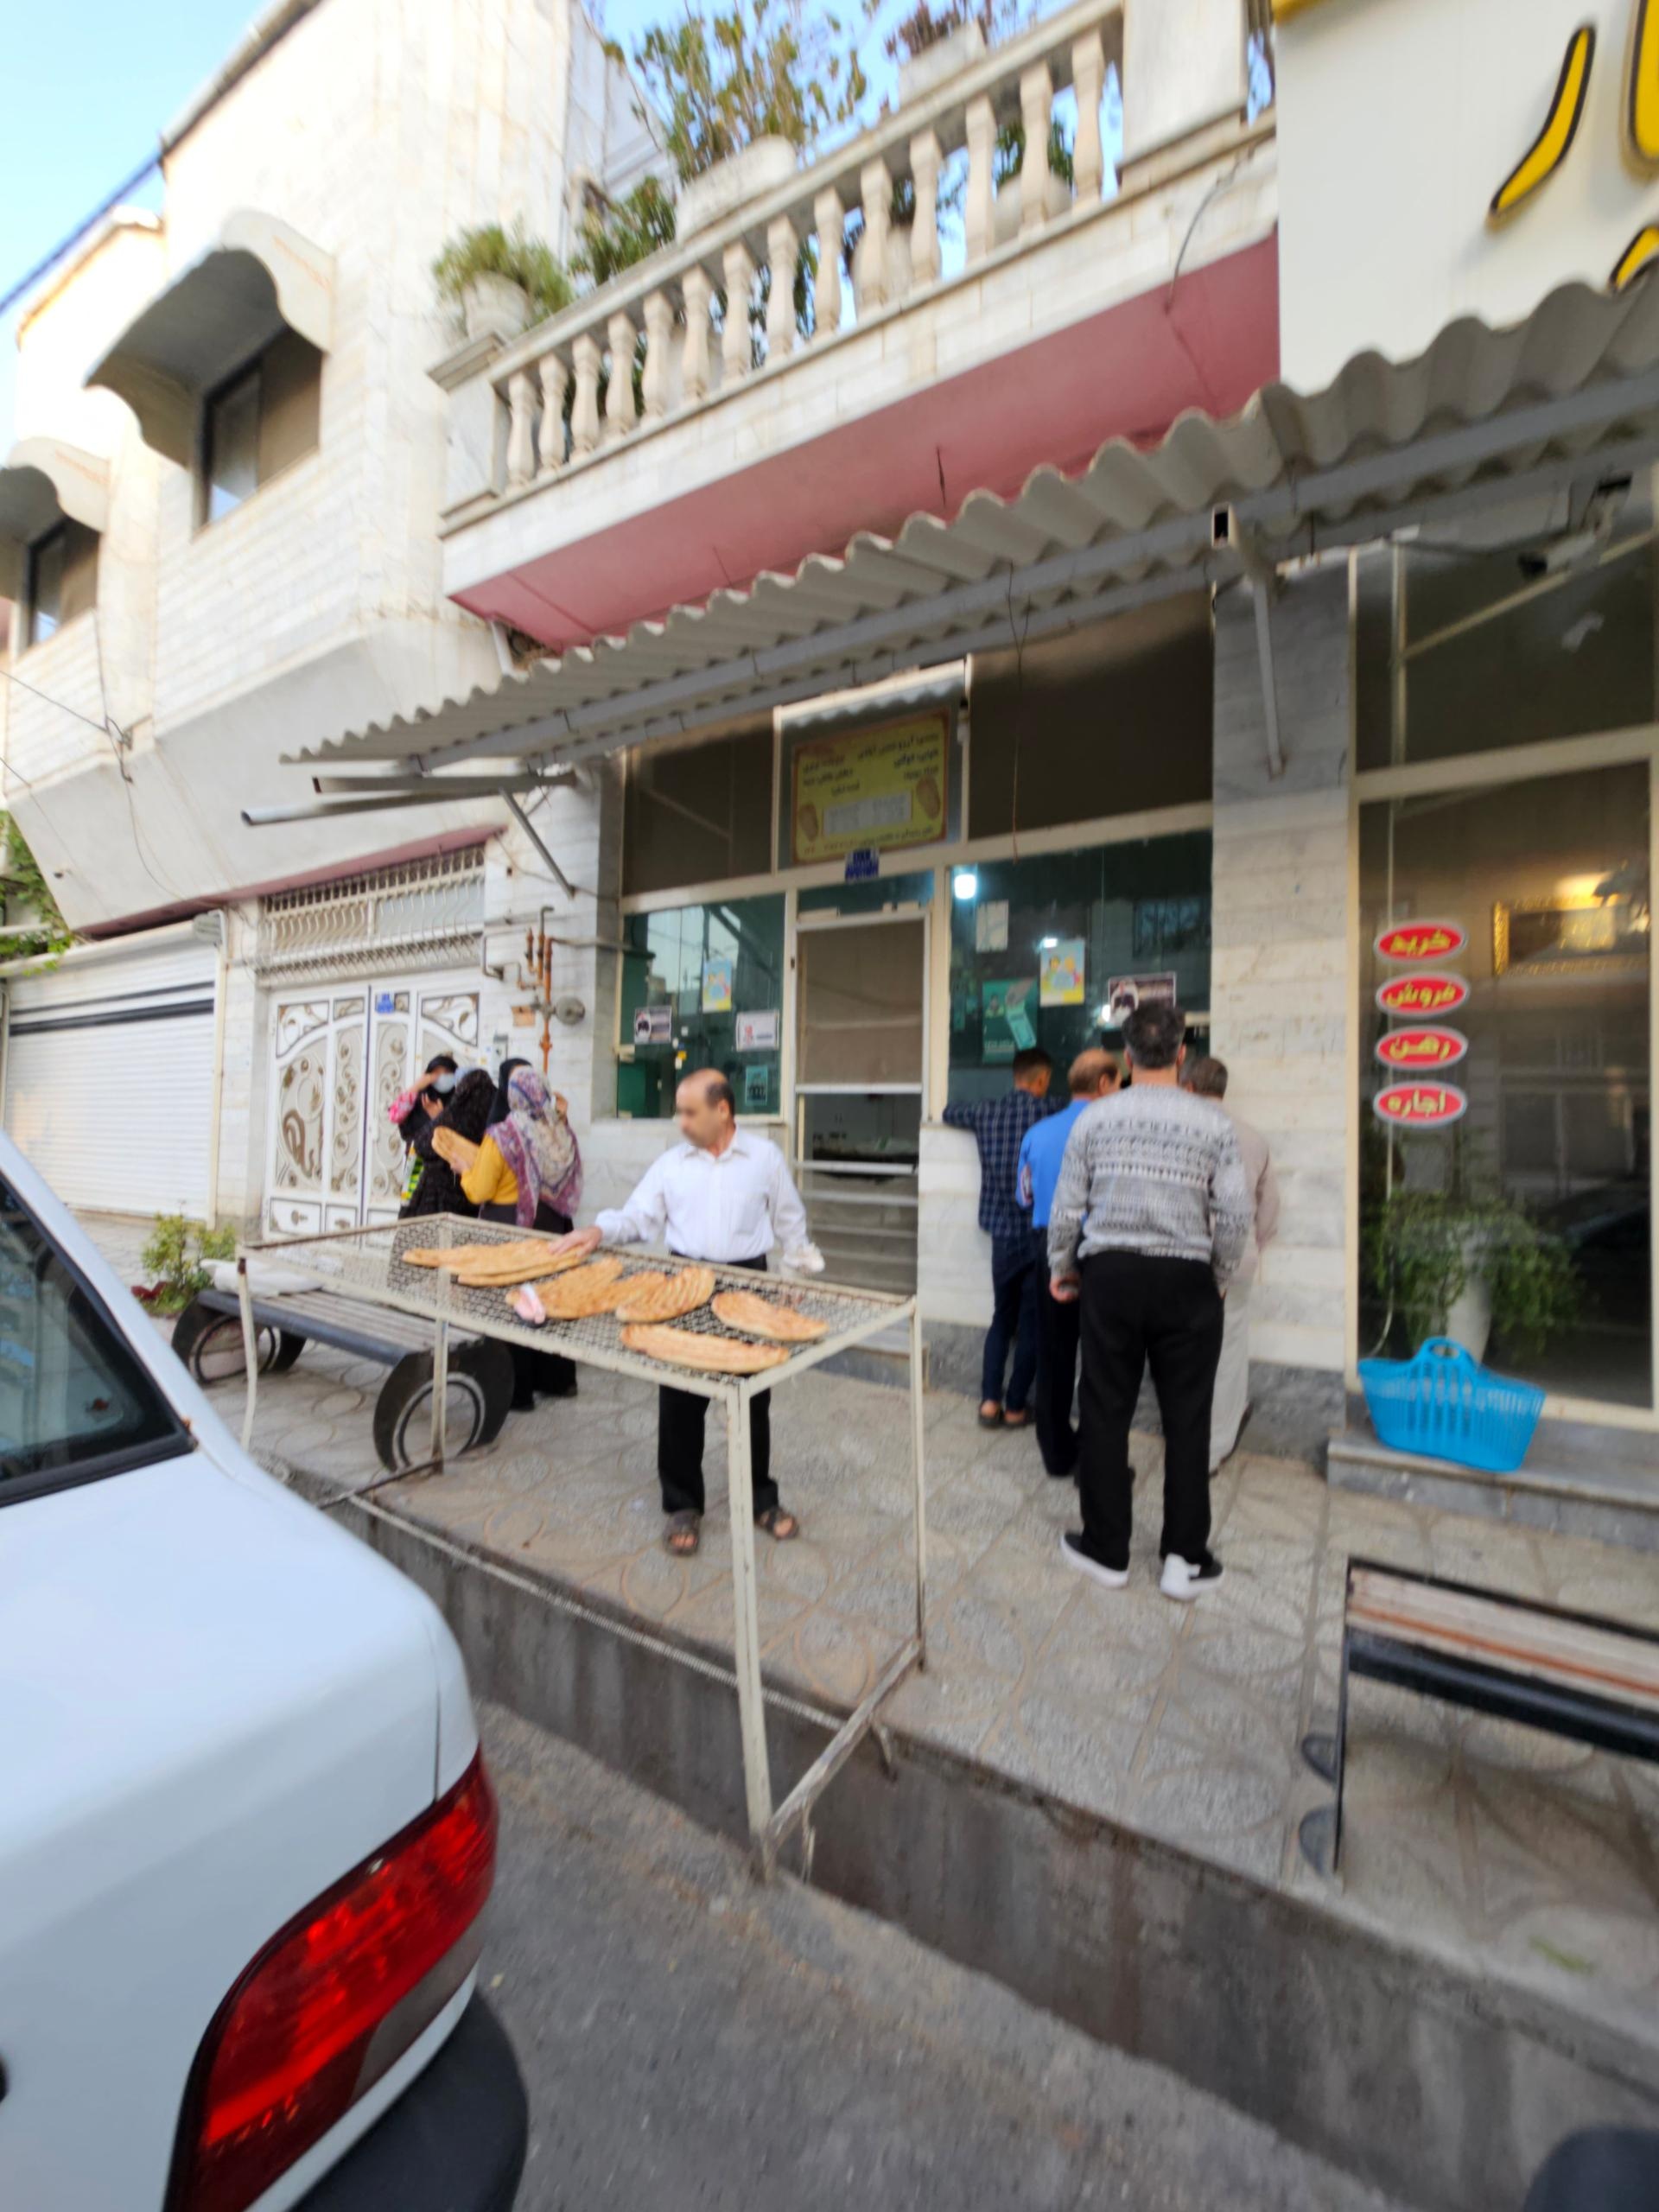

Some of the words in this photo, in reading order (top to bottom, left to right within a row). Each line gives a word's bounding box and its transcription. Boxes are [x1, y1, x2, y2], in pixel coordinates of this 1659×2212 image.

[1389, 929, 1451, 957] خرید
[1386, 982, 1456, 1007] فروش
[1389, 1035, 1451, 1060] رهن
[1388, 1089, 1446, 1116] اجاره
